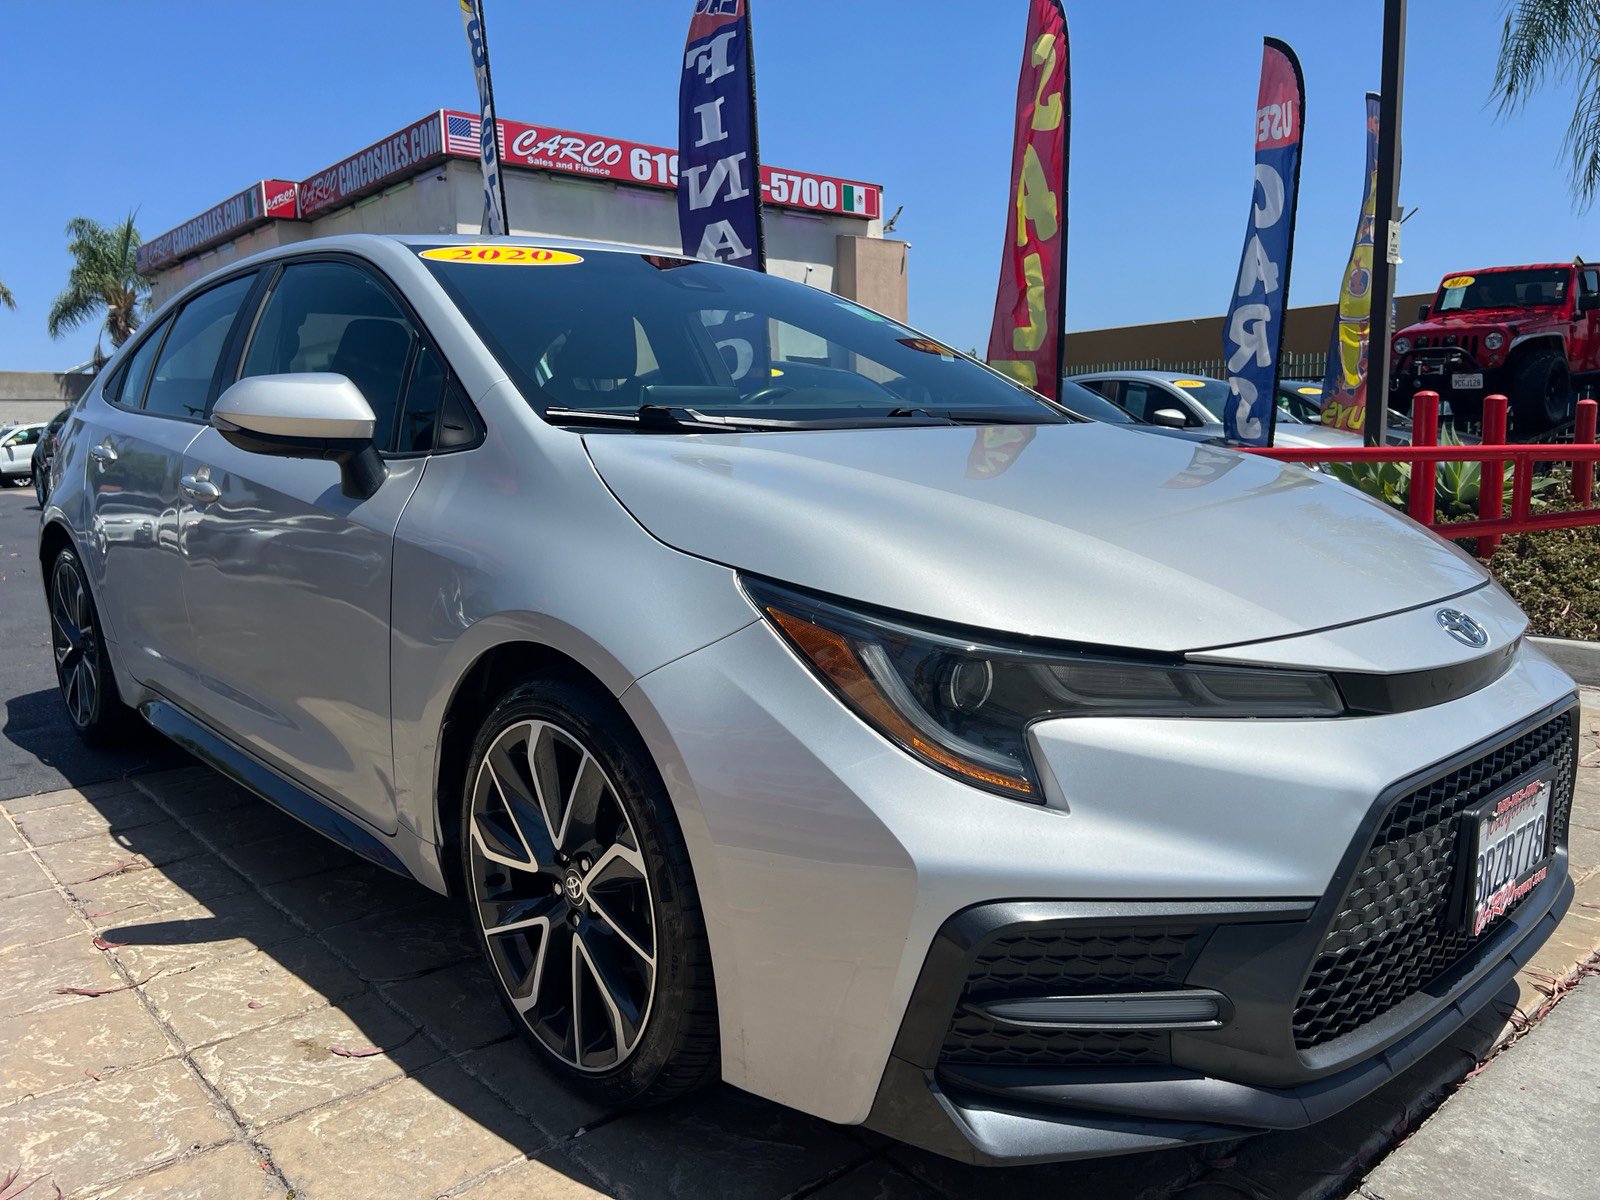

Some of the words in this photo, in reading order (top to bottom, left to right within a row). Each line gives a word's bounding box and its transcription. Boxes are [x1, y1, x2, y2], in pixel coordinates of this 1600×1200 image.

[338, 117, 441, 197] CARCOSALES.COM
[512, 129, 623, 167] CARCO
[527, 156, 554, 167] Sales
[556, 161, 573, 171] and
[575, 163, 611, 176] Finance
[265, 188, 295, 211] CARCO
[300, 169, 338, 210] CARCO
[172, 194, 246, 255] CARCOSALES.COM
[452, 249, 553, 261] 2020
